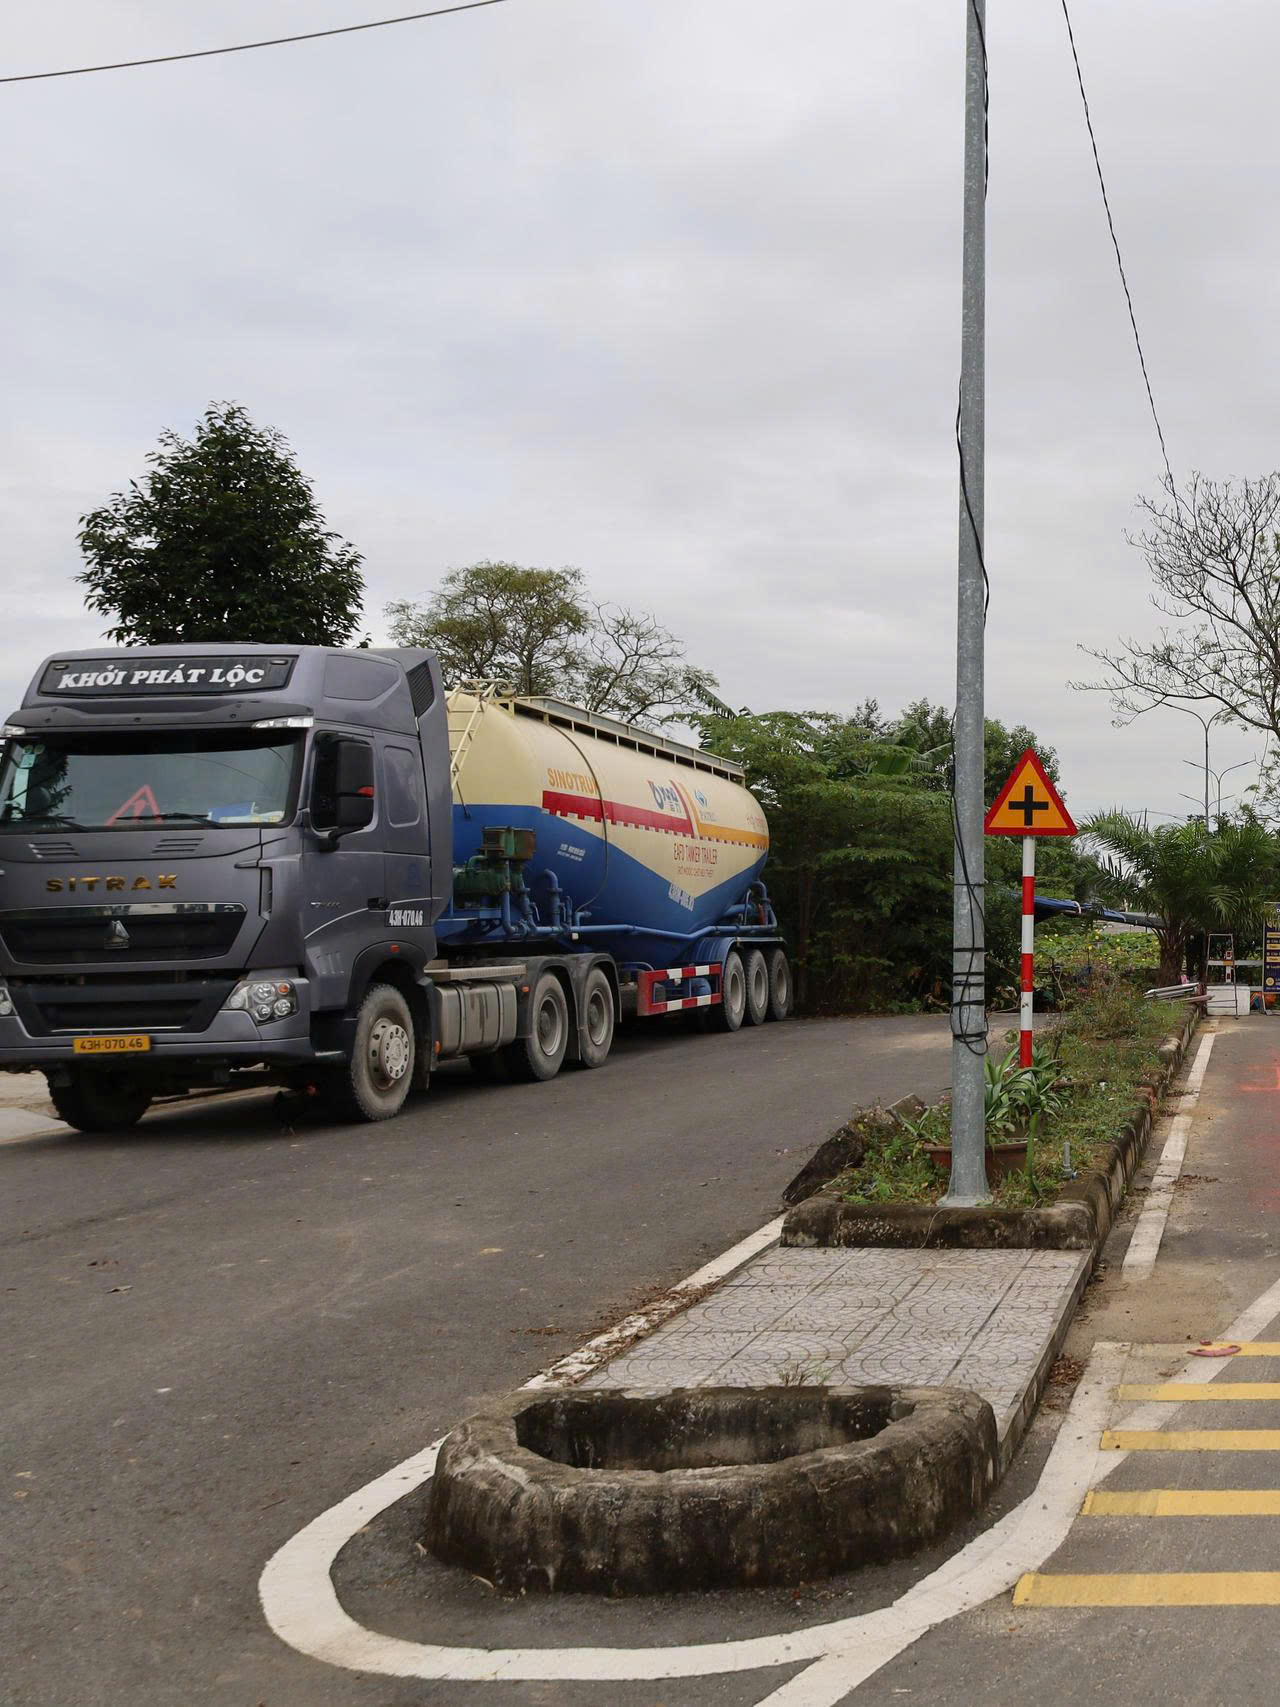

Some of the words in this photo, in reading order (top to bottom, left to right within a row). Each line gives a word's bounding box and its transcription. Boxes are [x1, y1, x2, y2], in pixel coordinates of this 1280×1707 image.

[57, 664, 127, 689] KHỞI
[130, 663, 206, 685] PHÁT
[209, 664, 265, 688] LỘC
[46, 874, 178, 892] SITRAK
[80, 1038, 143, 1050] 43H-070.46
